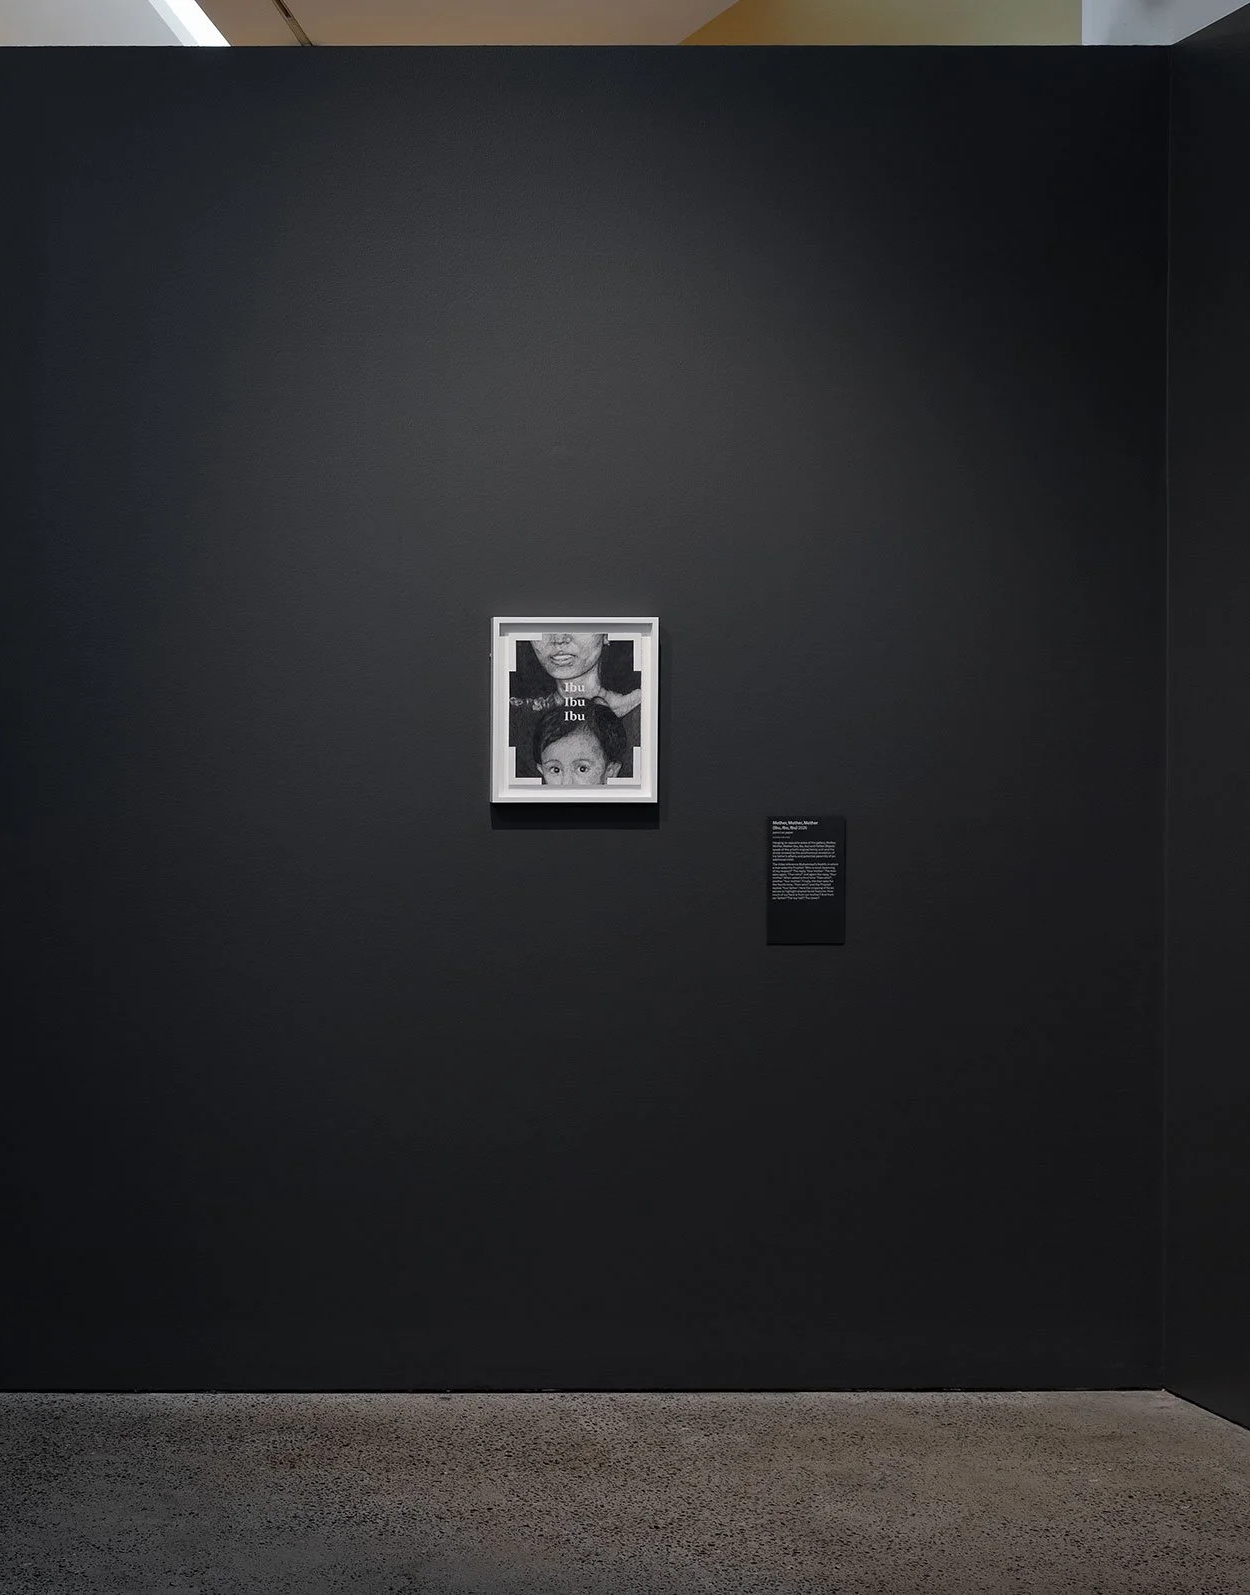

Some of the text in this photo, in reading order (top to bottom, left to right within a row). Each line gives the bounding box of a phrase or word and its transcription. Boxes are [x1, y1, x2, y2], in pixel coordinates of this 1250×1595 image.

[564, 682, 585, 692] Ibu
[564, 697, 586, 707] Ibu
[564, 711, 586, 721] Ibu
